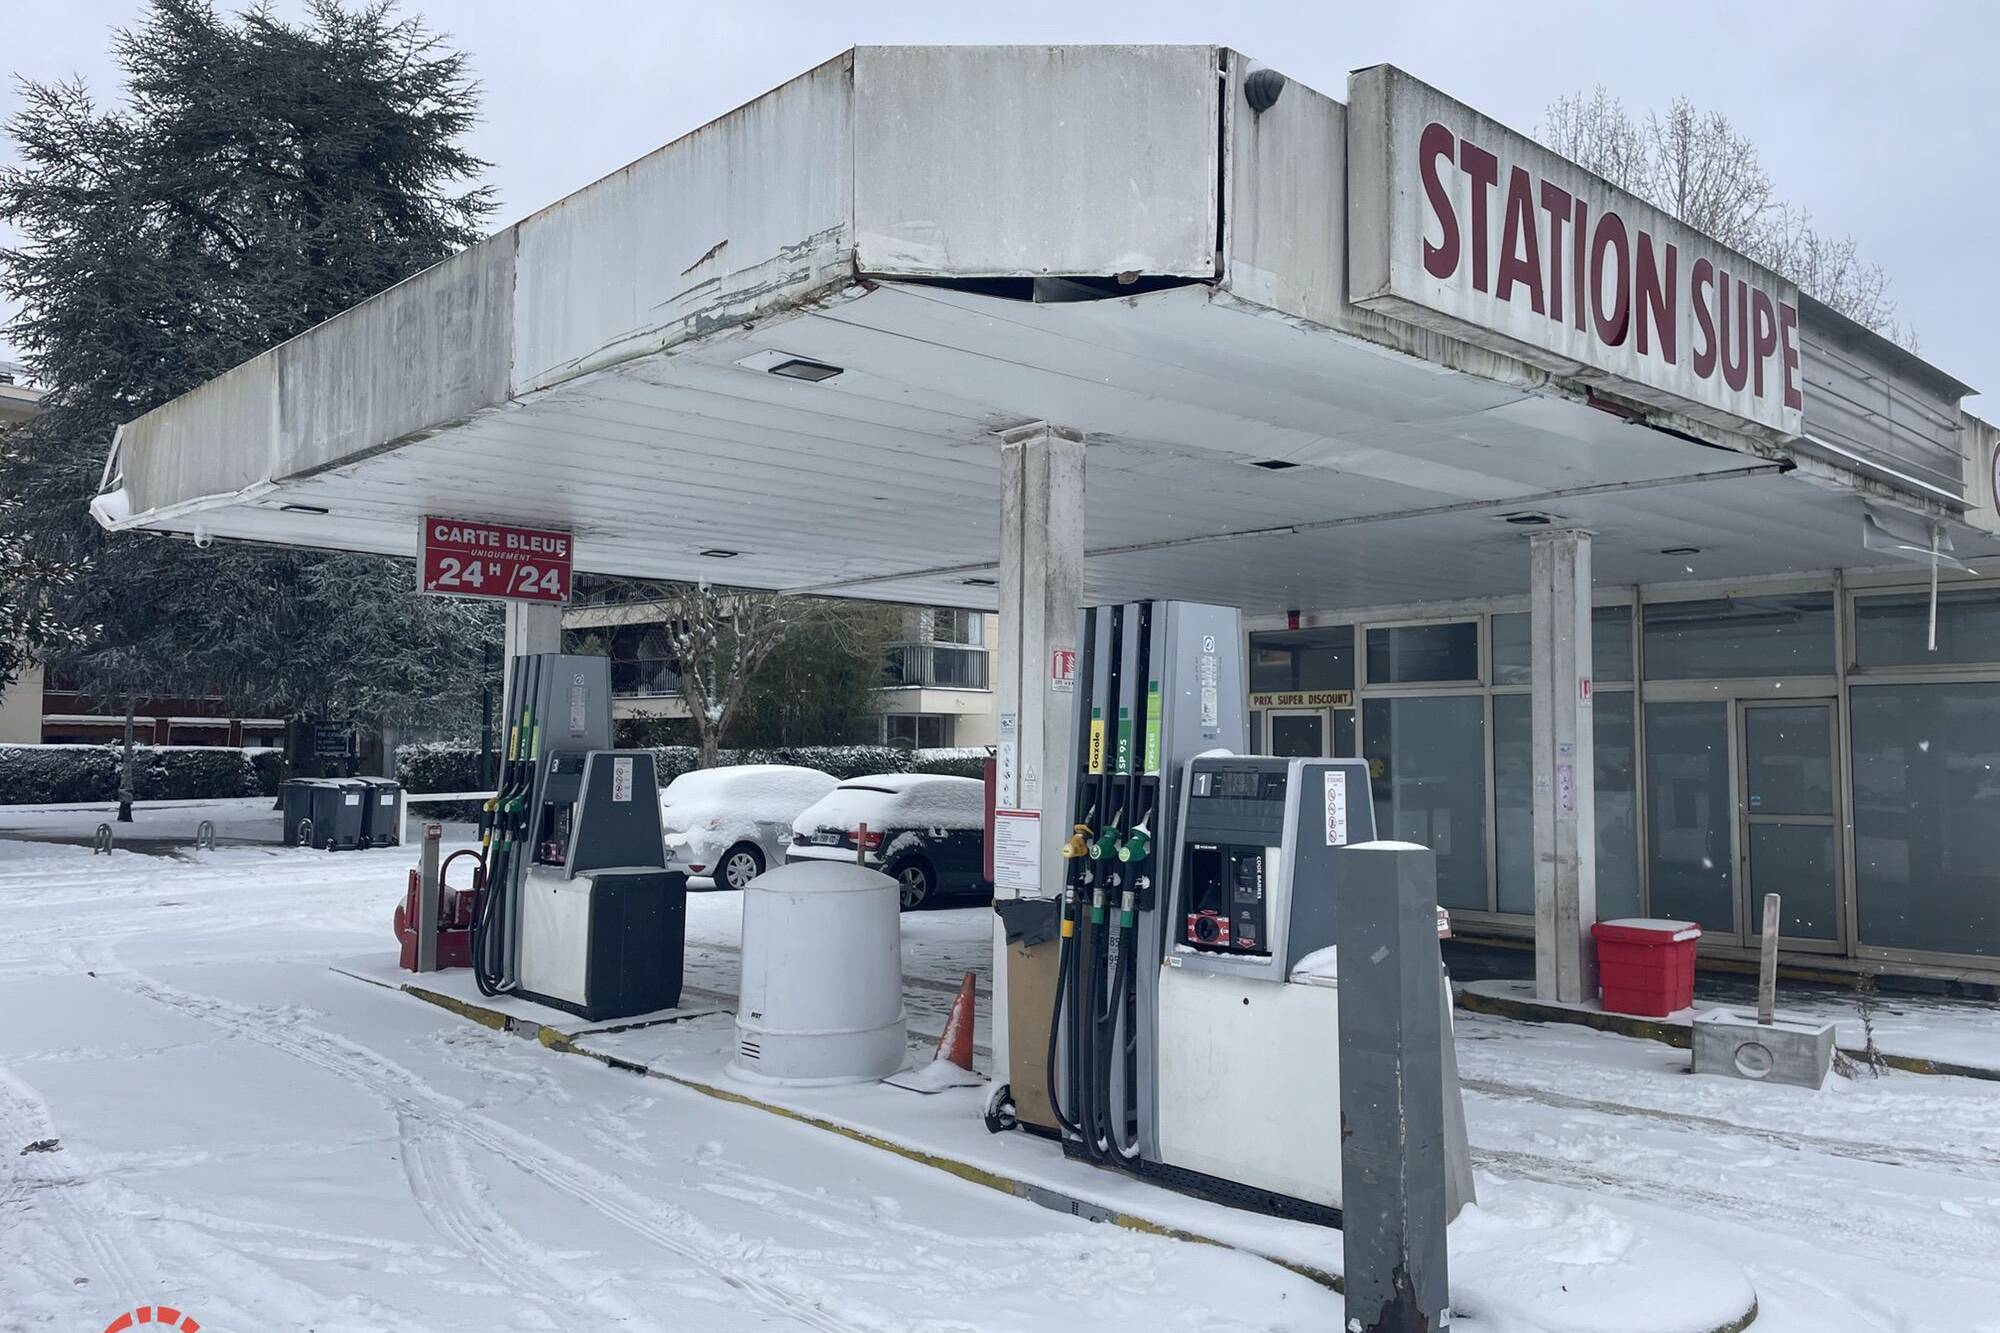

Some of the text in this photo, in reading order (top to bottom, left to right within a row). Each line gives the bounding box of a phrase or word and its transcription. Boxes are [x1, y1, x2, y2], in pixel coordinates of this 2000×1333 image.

[1419, 121, 1802, 411] STATION SUPE
[434, 525, 567, 554] CARTE BLEUE
[470, 549, 531, 562] UNIQUEMENT
[1254, 693, 1348, 705] PRIX SUPER DISCOUNT
[1092, 732, 1101, 768] Gazole
[1119, 739, 1128, 769] SP 95
[1199, 774, 1206, 795] 1
